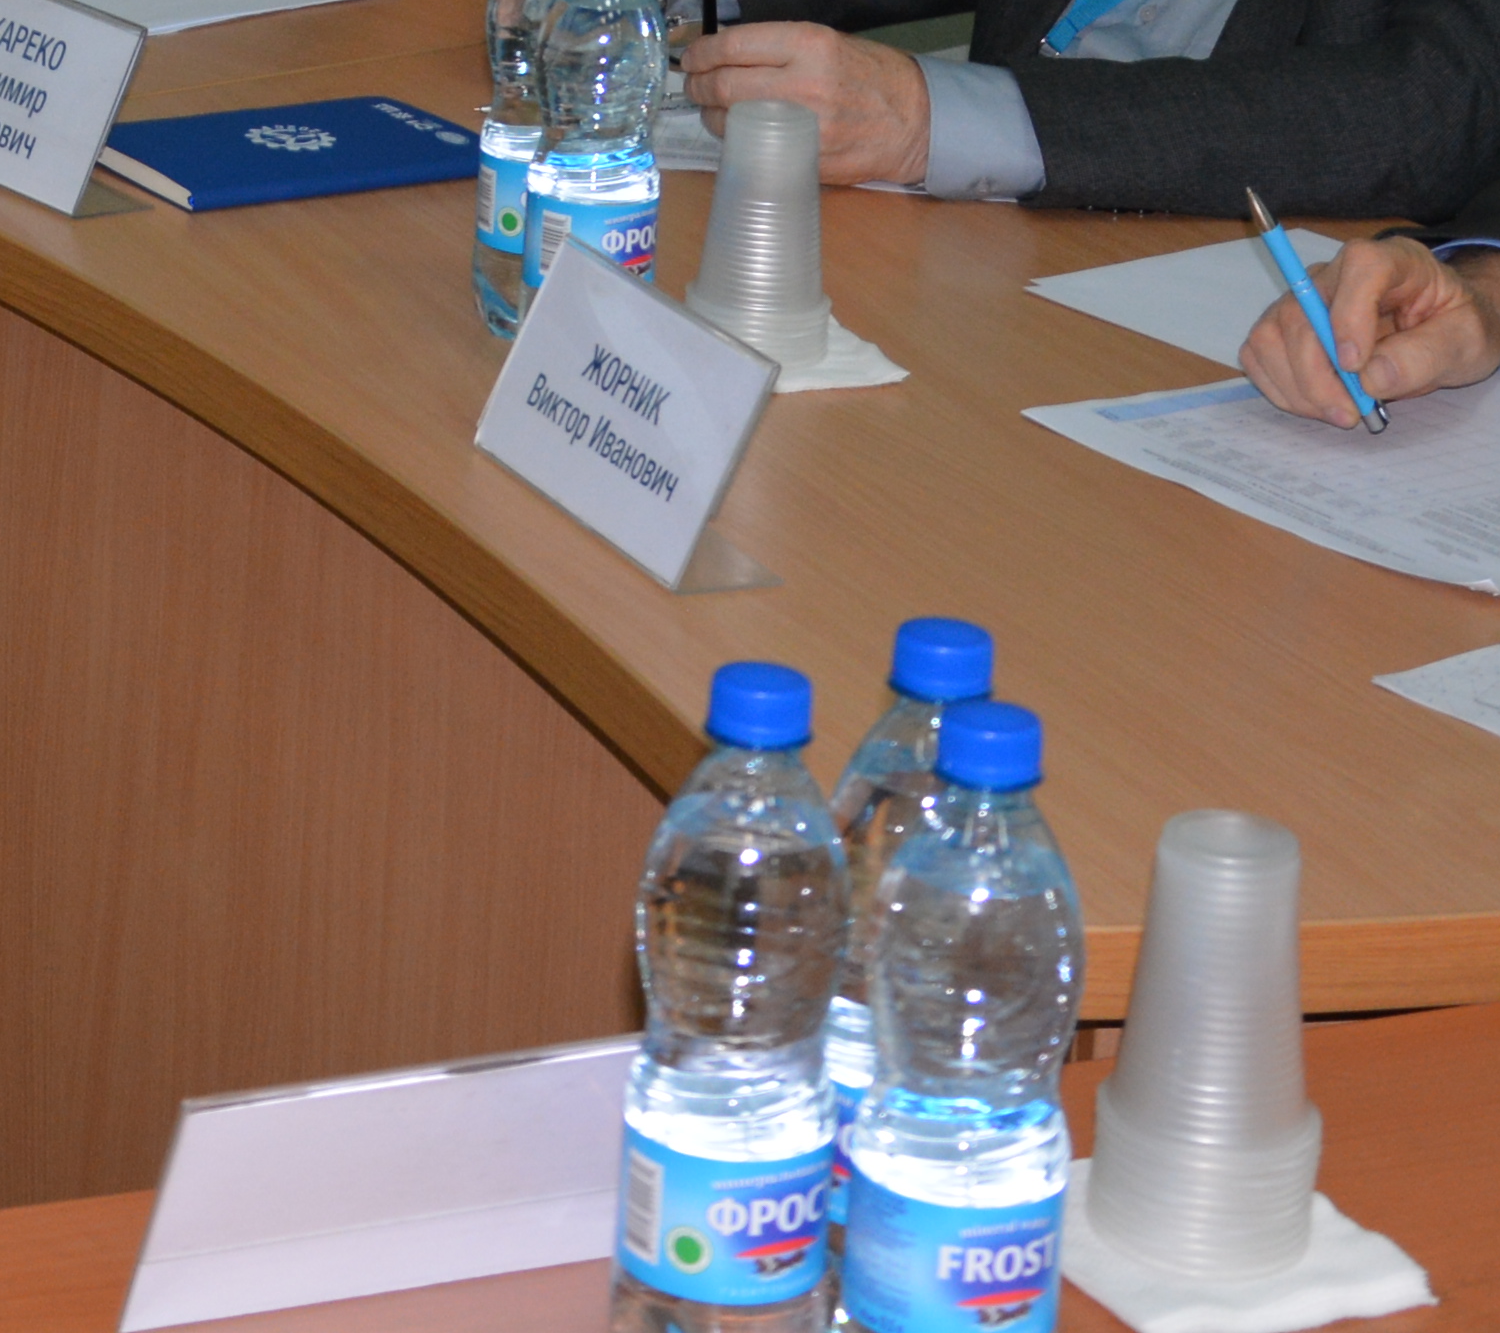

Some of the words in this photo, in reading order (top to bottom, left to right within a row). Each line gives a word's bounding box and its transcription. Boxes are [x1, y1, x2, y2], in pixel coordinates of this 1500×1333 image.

[582, 344, 670, 425] ЖОРНИК
[526, 372, 591, 445] Виктор
[588, 415, 679, 502] Иванович
[936, 1233, 1056, 1284] FROST
